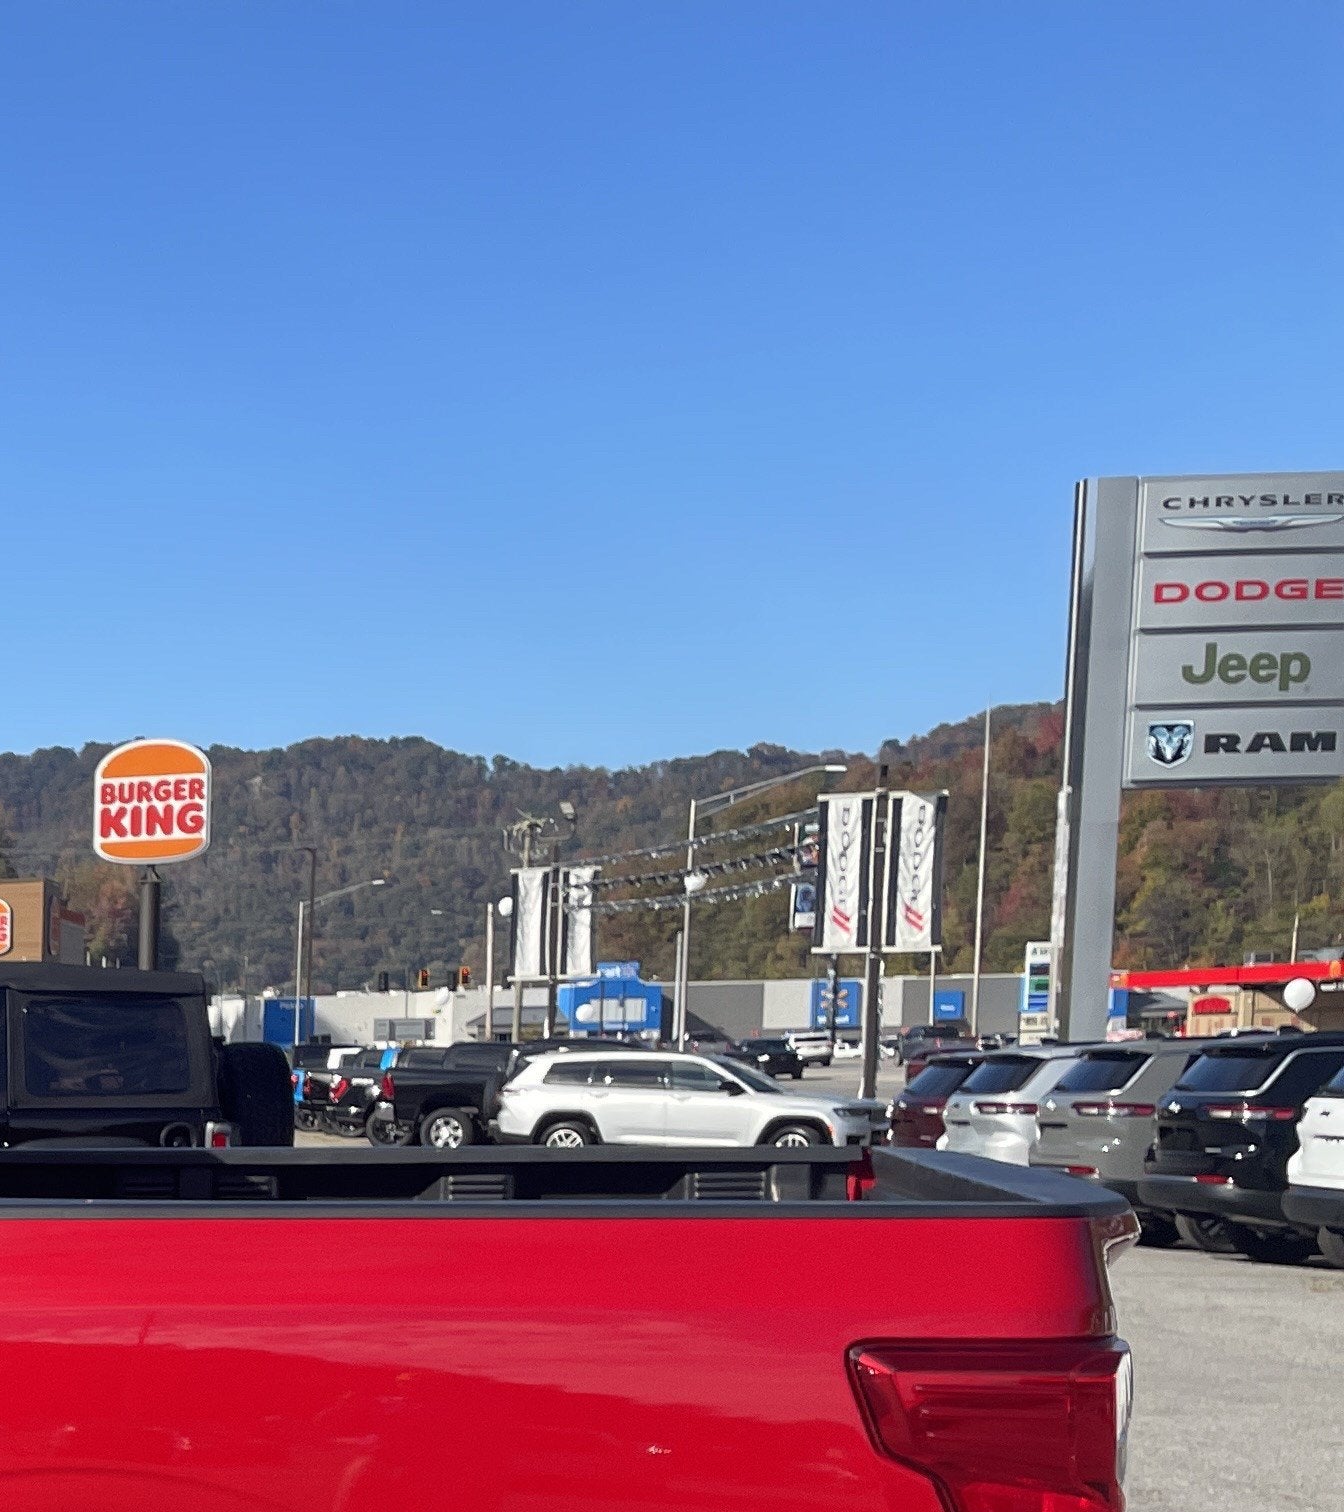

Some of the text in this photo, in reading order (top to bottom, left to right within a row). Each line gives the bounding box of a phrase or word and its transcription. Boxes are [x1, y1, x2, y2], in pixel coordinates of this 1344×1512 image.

[1162, 493, 1344, 510] CHRYSLER
[1153, 578, 1344, 604] DODGE
[1181, 642, 1311, 691] Jeep
[1204, 731, 1337, 754] RAM
[100, 778, 205, 805] BURGER
[100, 803, 205, 838] KING
